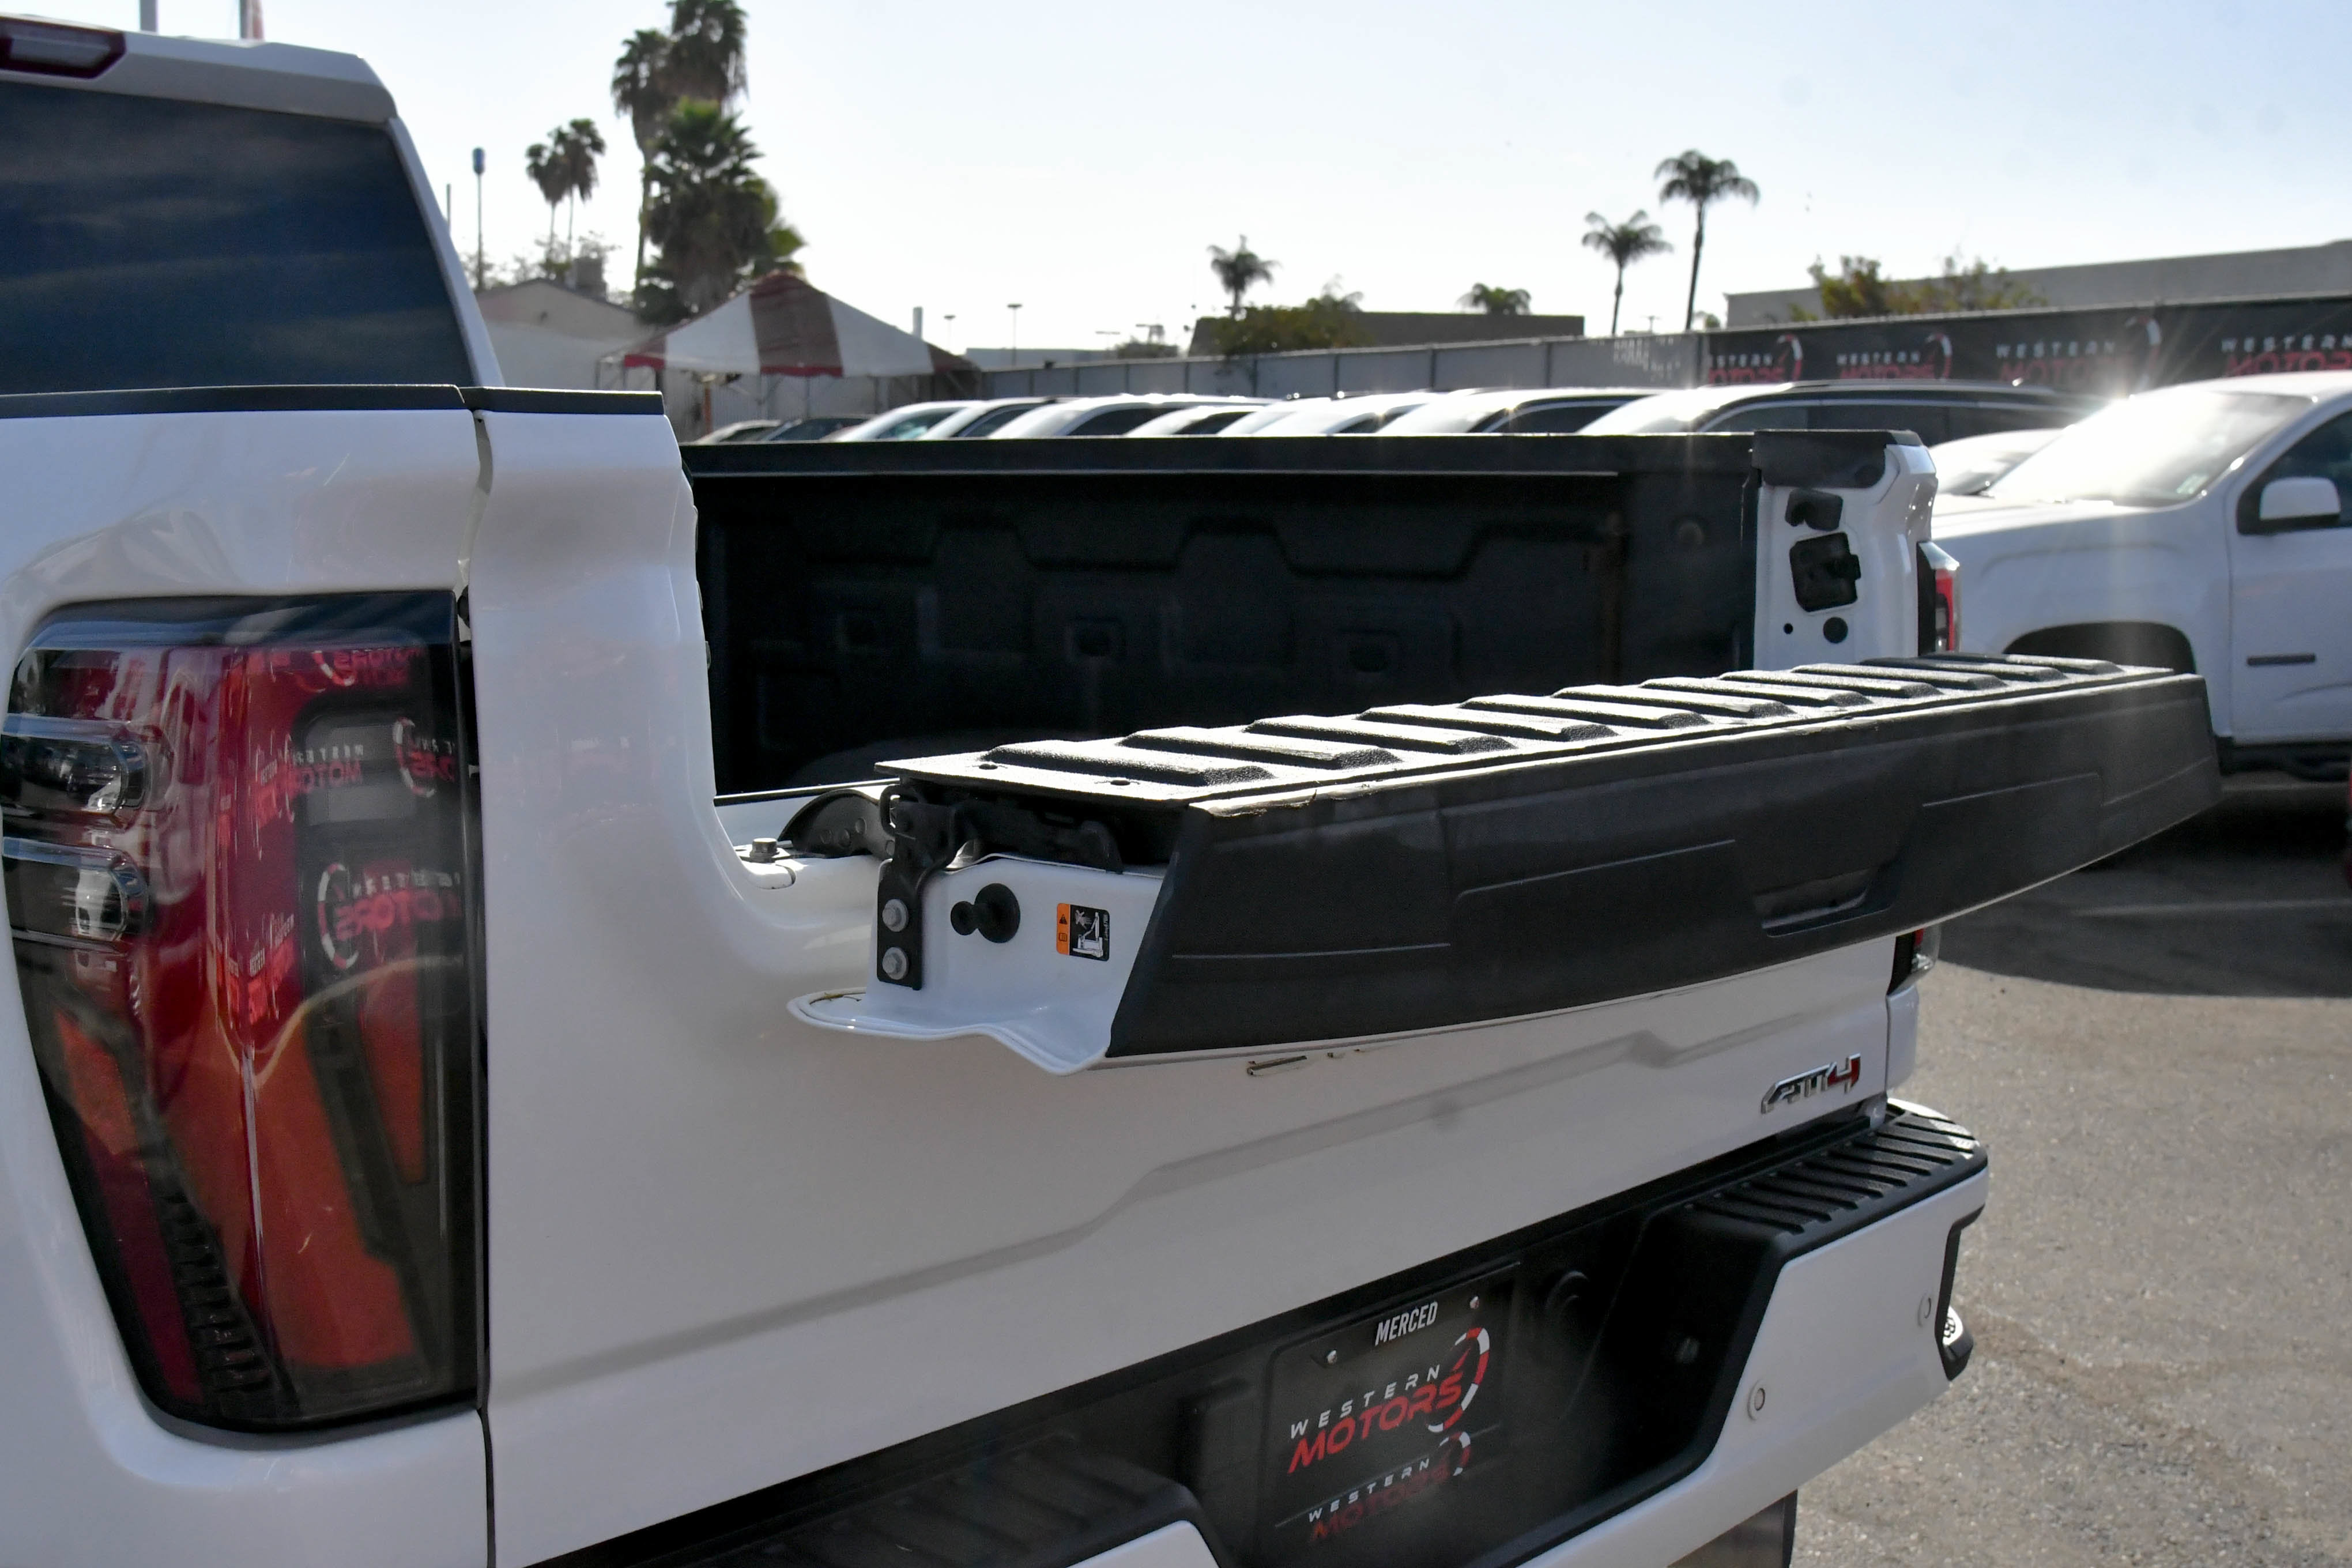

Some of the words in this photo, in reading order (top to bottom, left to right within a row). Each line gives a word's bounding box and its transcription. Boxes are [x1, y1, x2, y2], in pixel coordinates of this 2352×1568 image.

[1374, 1301, 1439, 1347] MERCED
[1287, 1370, 1464, 1475] MOTORS
[1290, 1365, 1440, 1439] WESTERN
[1308, 1458, 1430, 1522] WESTERN
